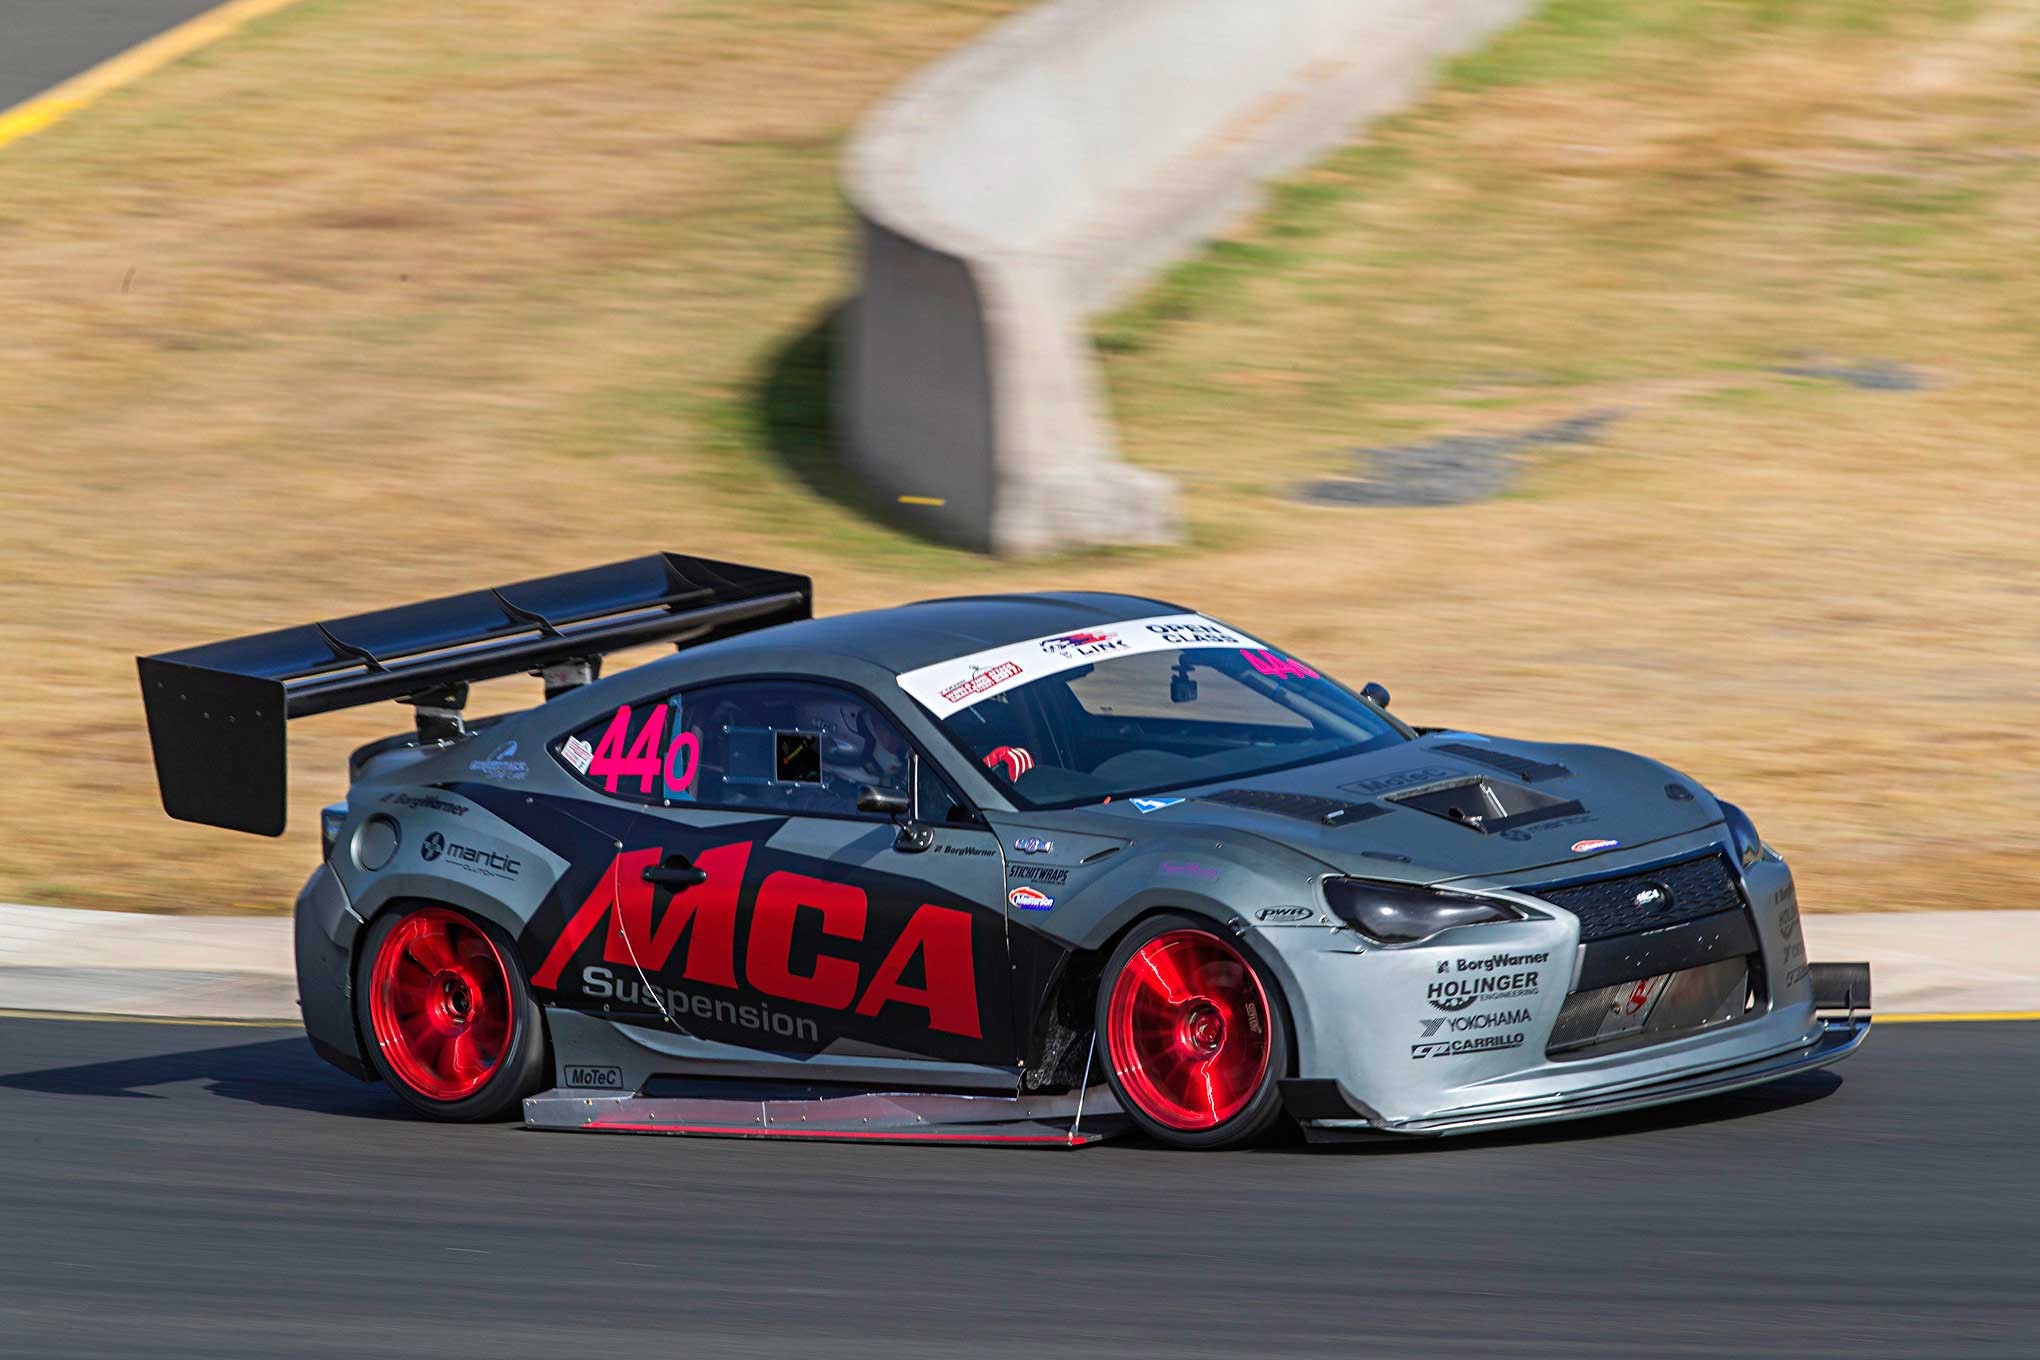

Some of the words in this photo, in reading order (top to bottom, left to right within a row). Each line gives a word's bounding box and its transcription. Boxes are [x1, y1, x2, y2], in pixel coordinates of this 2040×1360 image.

[1145, 623, 1223, 635] OPEN
[1163, 633, 1239, 644] CLASS
[588, 703, 700, 794] 440
[393, 792, 469, 816] BorgWarner
[446, 842, 521, 875] mantic
[944, 845, 997, 857] BorgWarner
[530, 840, 982, 1039] MCA
[1456, 951, 1550, 972] BorgWarner
[1427, 971, 1540, 999] HOLINGER
[1479, 988, 1539, 1002] ENGINEERING
[581, 965, 819, 1042] Suspension
[1447, 1008, 1532, 1033] YOKOHAMA
[1451, 1033, 1525, 1051] CARRILLO
[572, 1068, 617, 1085] MoTeC
